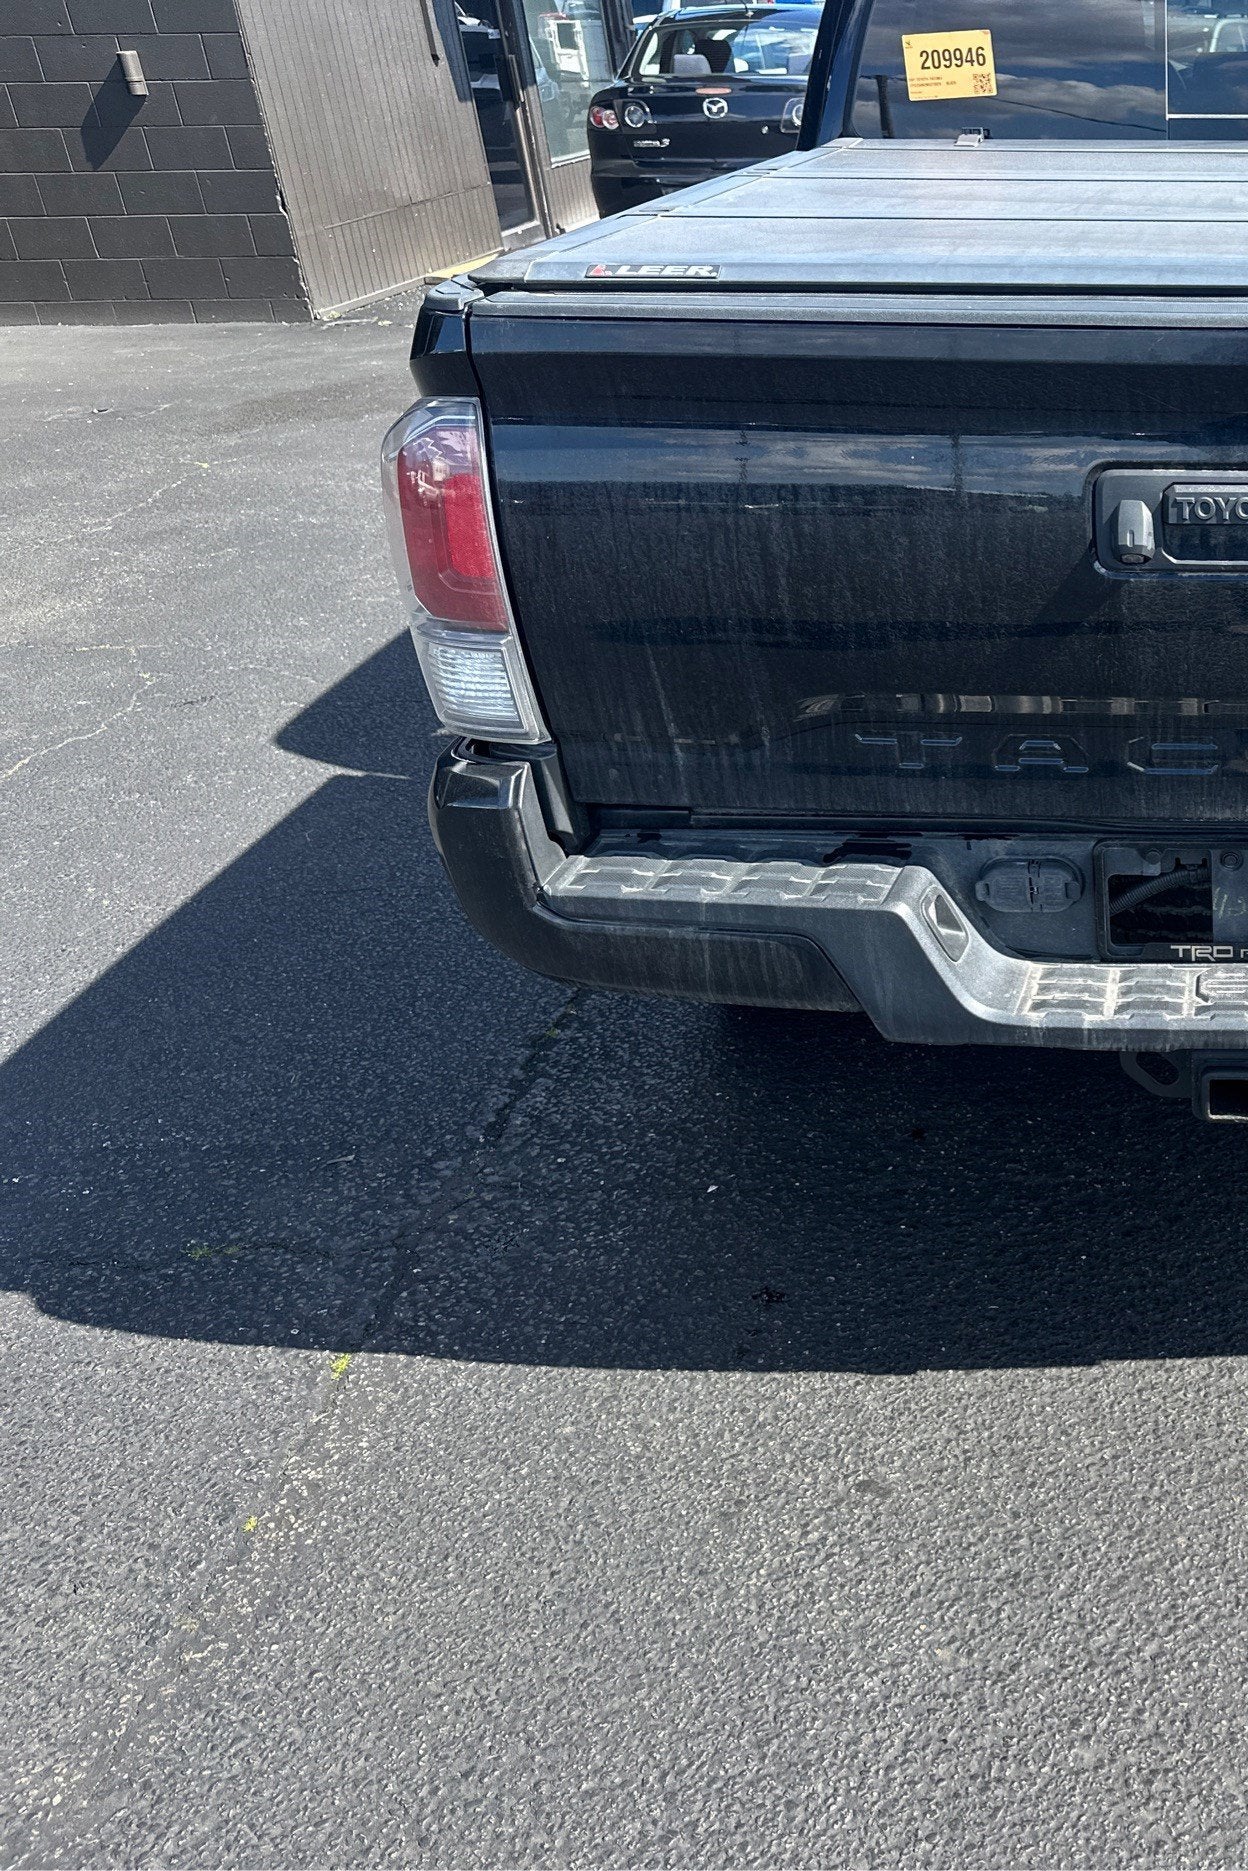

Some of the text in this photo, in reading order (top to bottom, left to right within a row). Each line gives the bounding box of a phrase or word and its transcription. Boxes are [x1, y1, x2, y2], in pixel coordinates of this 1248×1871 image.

[920, 46, 986, 70] 209946
[615, 265, 713, 277] LEER
[1170, 945, 1234, 962] TRD
